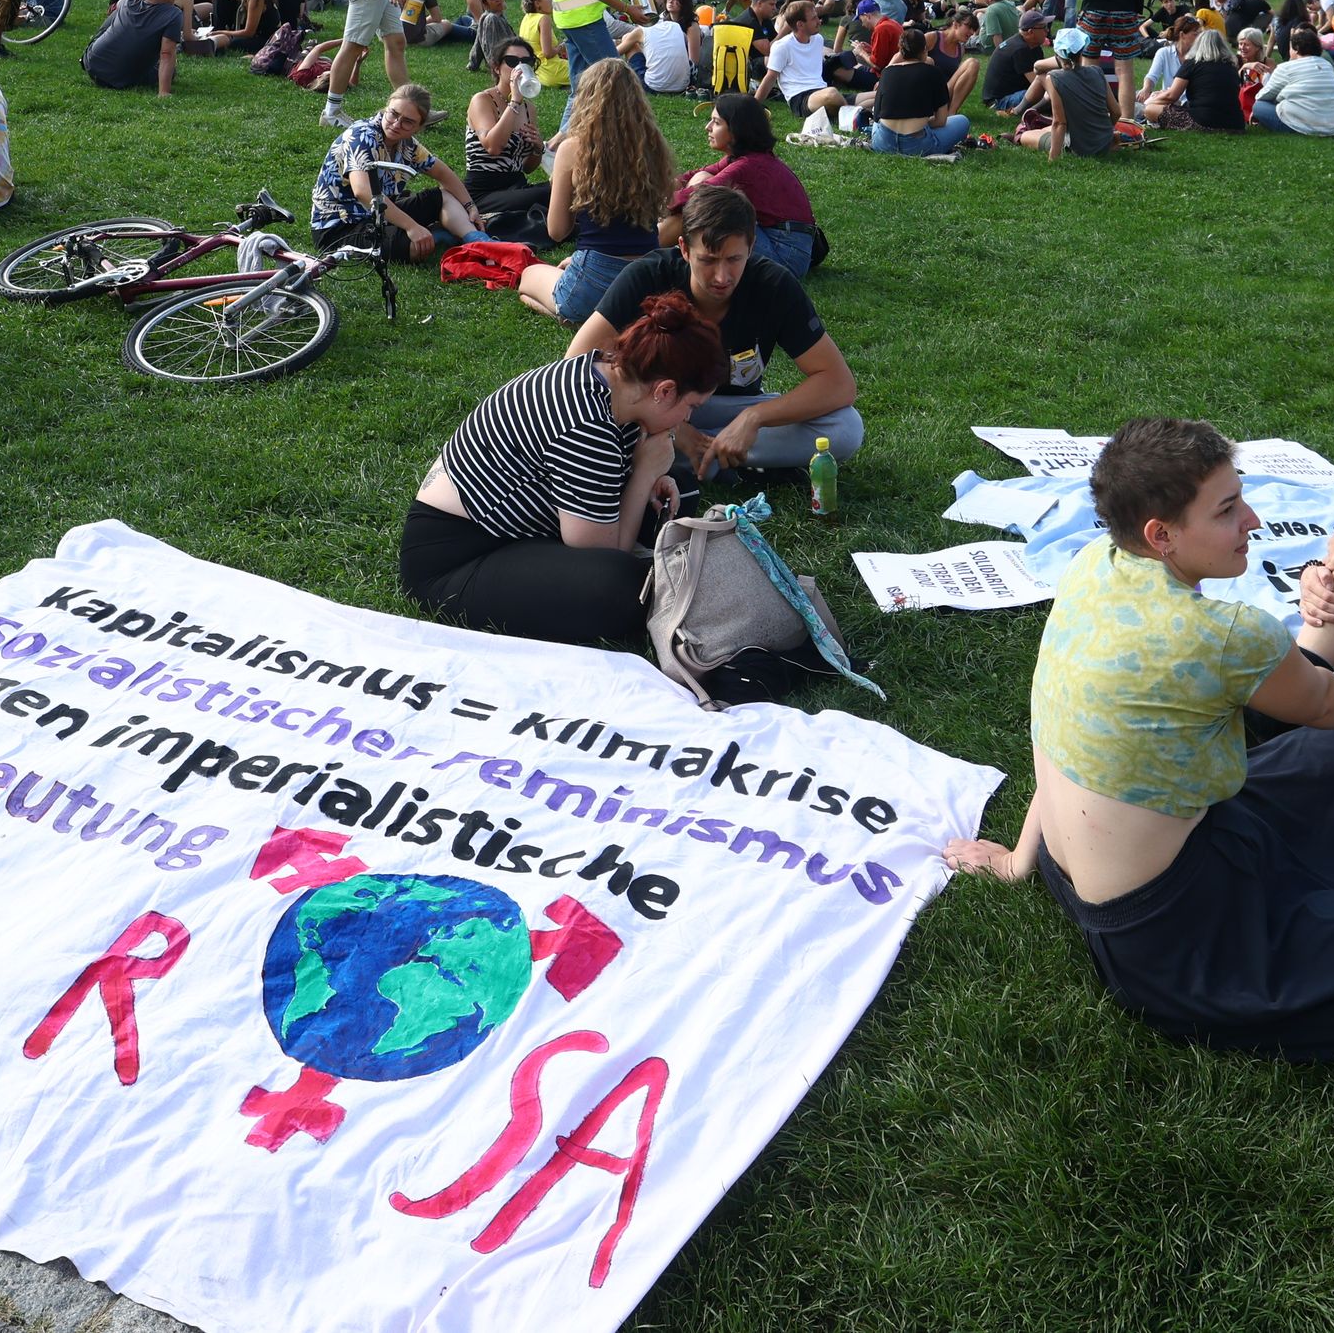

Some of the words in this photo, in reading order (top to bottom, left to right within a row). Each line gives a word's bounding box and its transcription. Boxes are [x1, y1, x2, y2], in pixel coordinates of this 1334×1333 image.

[927, 562, 957, 587] STREIK
[943, 584, 966, 598] BEI
[951, 561, 974, 579] MIT
[965, 576, 986, 594] DEM
[969, 550, 1016, 598] SOLIDARITÄT
[39, 586, 448, 712] Kapitalismus
[510, 711, 898, 835] Klimakrise
[91, 715, 682, 920] imperialistische
